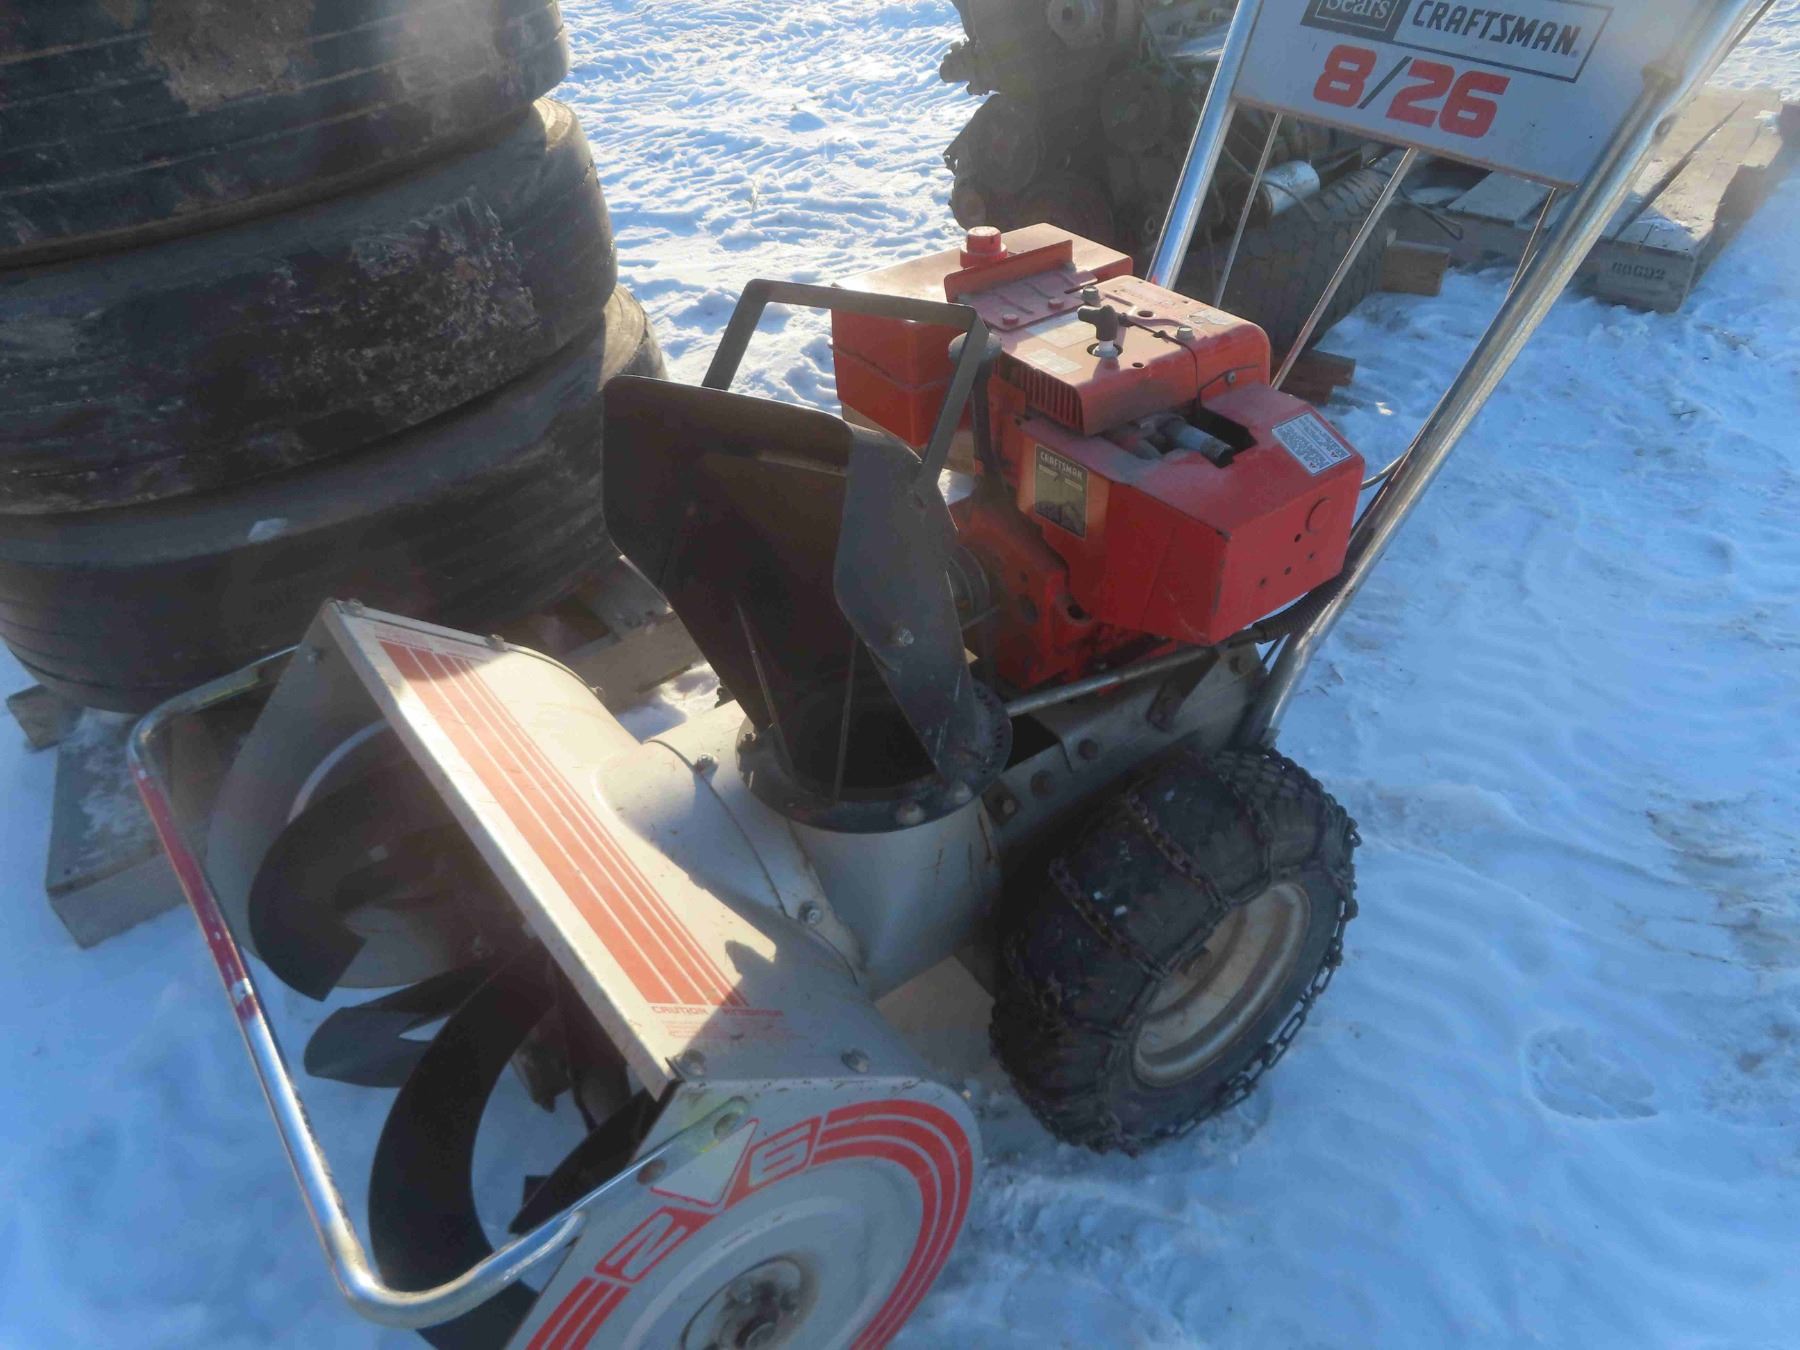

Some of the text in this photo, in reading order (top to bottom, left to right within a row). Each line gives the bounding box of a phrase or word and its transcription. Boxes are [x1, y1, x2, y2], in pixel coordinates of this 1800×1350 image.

[1412, 0, 1582, 56] CRAFTSMAN
[1313, 44, 1511, 139] 8/26
[1040, 451, 1084, 480] CRAFTSMAN
